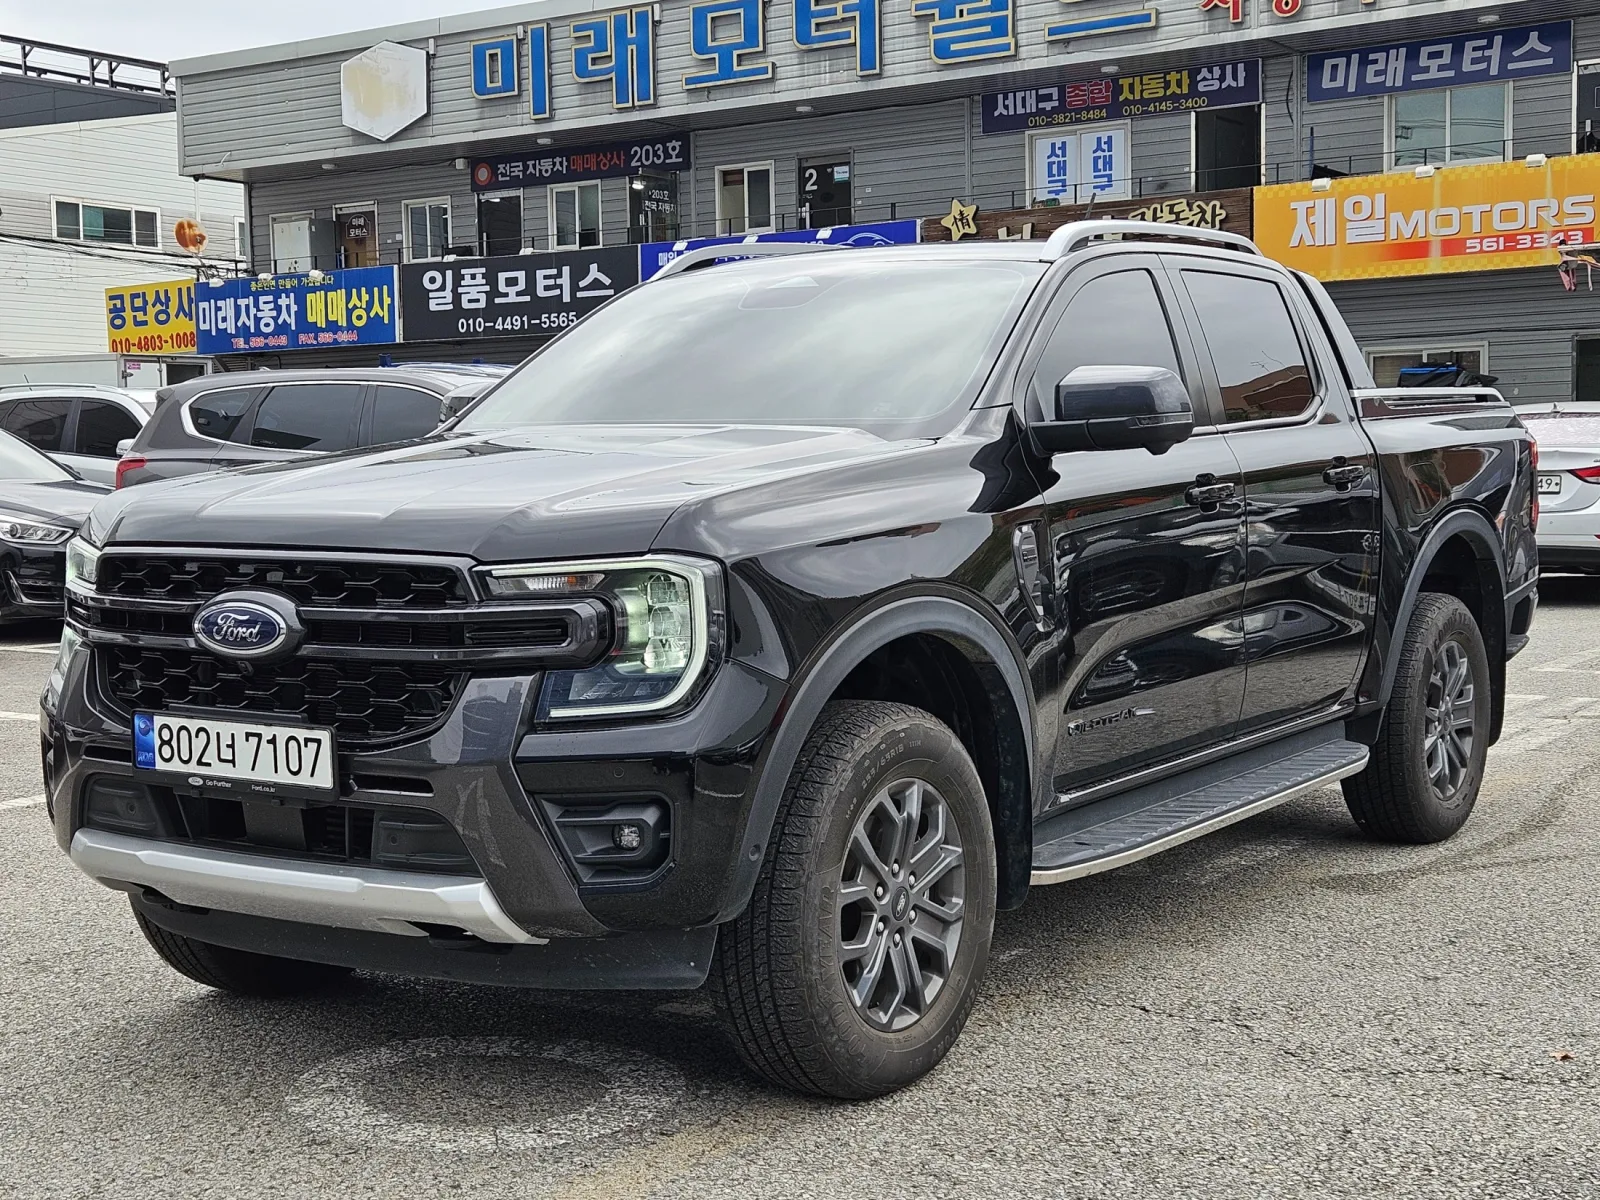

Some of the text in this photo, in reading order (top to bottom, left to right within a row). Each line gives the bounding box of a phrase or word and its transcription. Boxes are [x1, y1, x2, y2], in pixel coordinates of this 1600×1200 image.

[1322, 31, 1554, 93] 미래모터스
[994, 63, 1246, 117] 서대구 종합 자동차 상사
[1028, 96, 1208, 127] 010-3821-8484 010-4145-3400
[497, 140, 683, 181] 전국 자동차 매매상사 203호
[1047, 141, 1067, 196] 서대구
[1093, 135, 1113, 192] 서대구
[951, 207, 973, 233] 情
[1465, 230, 1584, 254] 561-3343
[108, 286, 195, 330] 공단상사
[422, 263, 615, 312] 일품모터스
[199, 285, 391, 335] 미래자동차 매매상사
[458, 312, 577, 333] 010-4491-5565
[111, 330, 196, 353] 010-4803-1008
[213, 612, 261, 643] Ford
